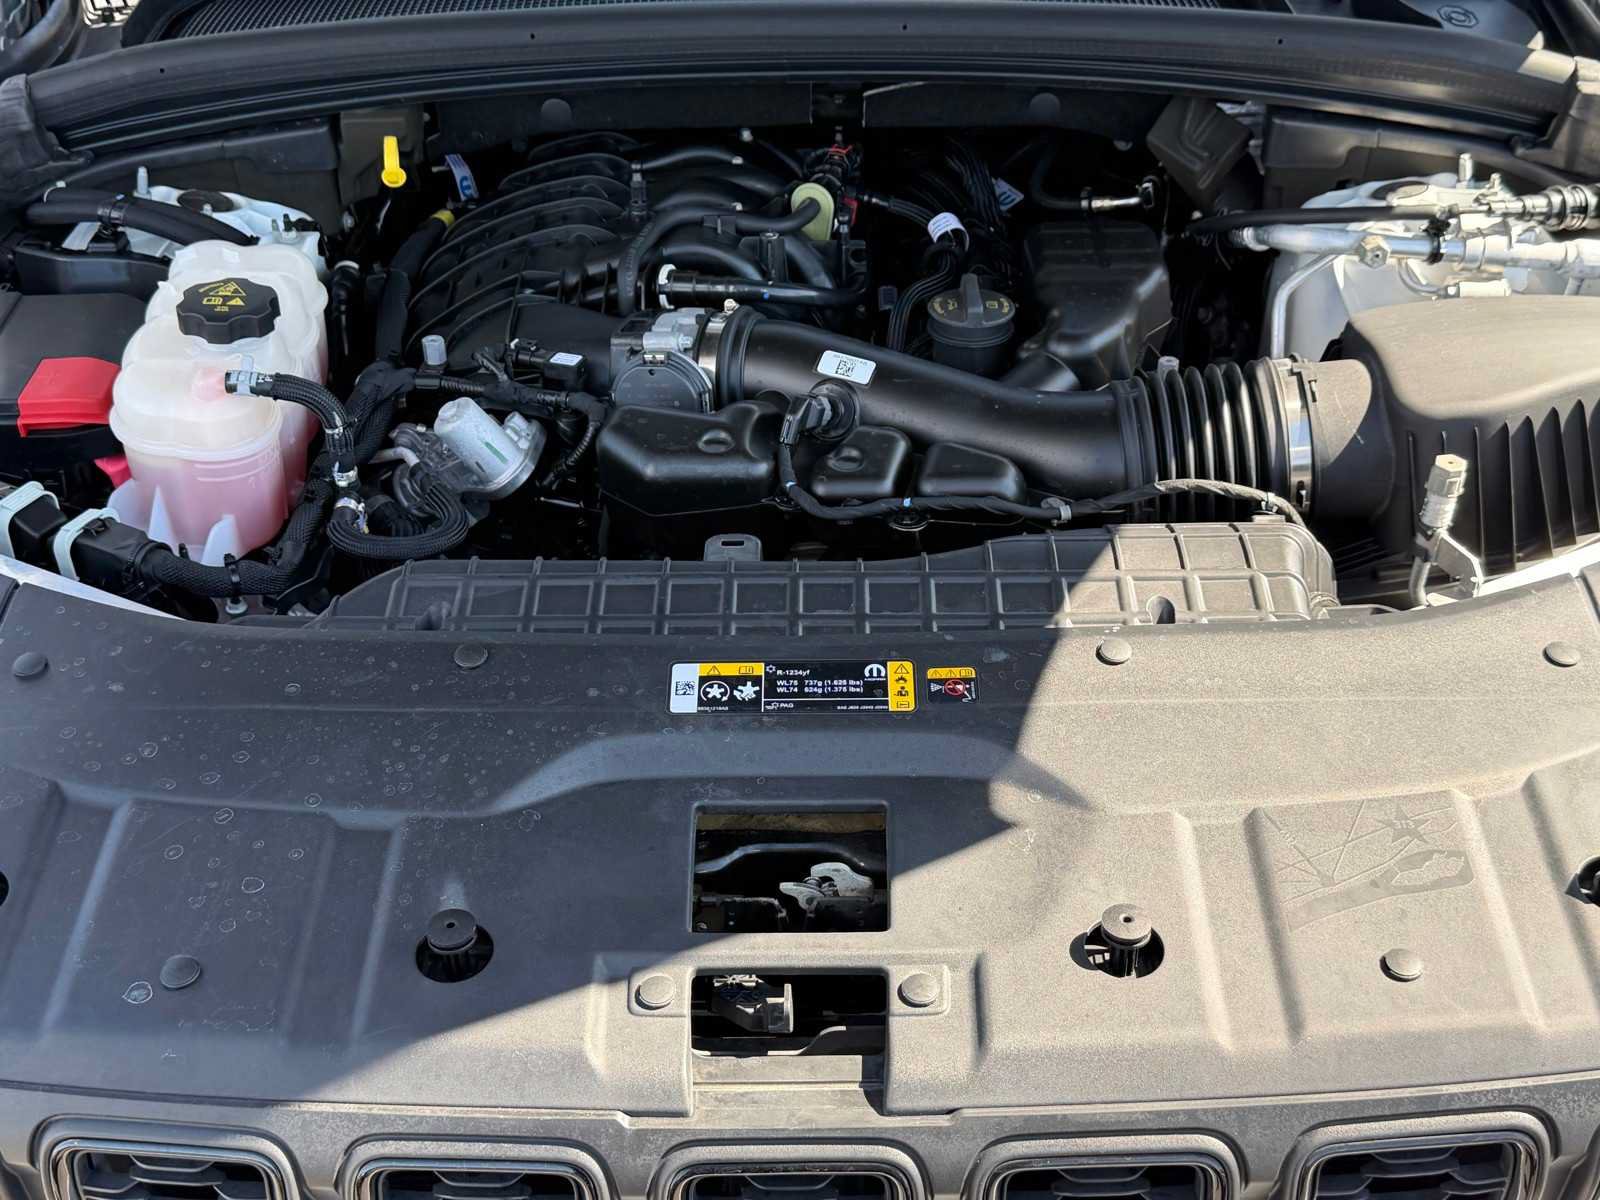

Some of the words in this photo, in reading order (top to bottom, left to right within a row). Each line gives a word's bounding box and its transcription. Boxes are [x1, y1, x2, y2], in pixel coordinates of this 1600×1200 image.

[776, 669, 810, 677] R-1234yf
[804, 679, 823, 687] 737g
[849, 679, 864, 687] lbs)
[804, 686, 823, 694] 624g
[849, 686, 864, 694] lbs)
